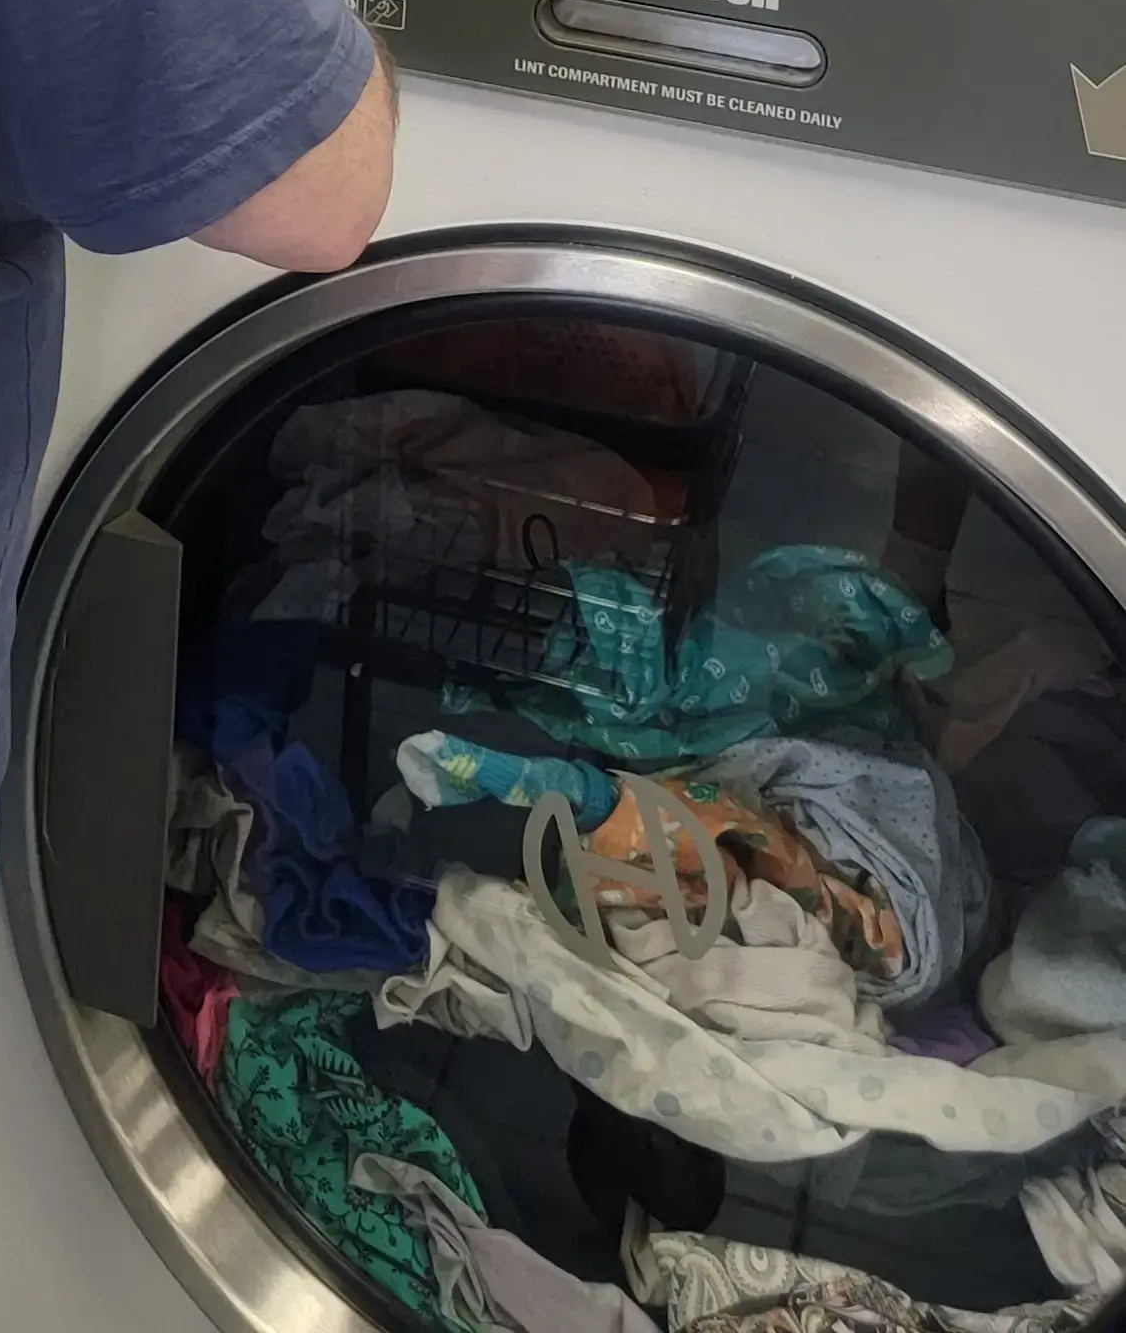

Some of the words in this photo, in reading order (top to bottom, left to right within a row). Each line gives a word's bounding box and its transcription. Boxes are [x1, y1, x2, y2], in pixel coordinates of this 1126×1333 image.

[514, 58, 546, 76] LINT
[548, 64, 659, 97] COMPARTMENT
[661, 85, 704, 106] MUST
[706, 94, 726, 109] BE
[728, 97, 797, 123] CLEANED
[800, 110, 843, 131] DAILY
